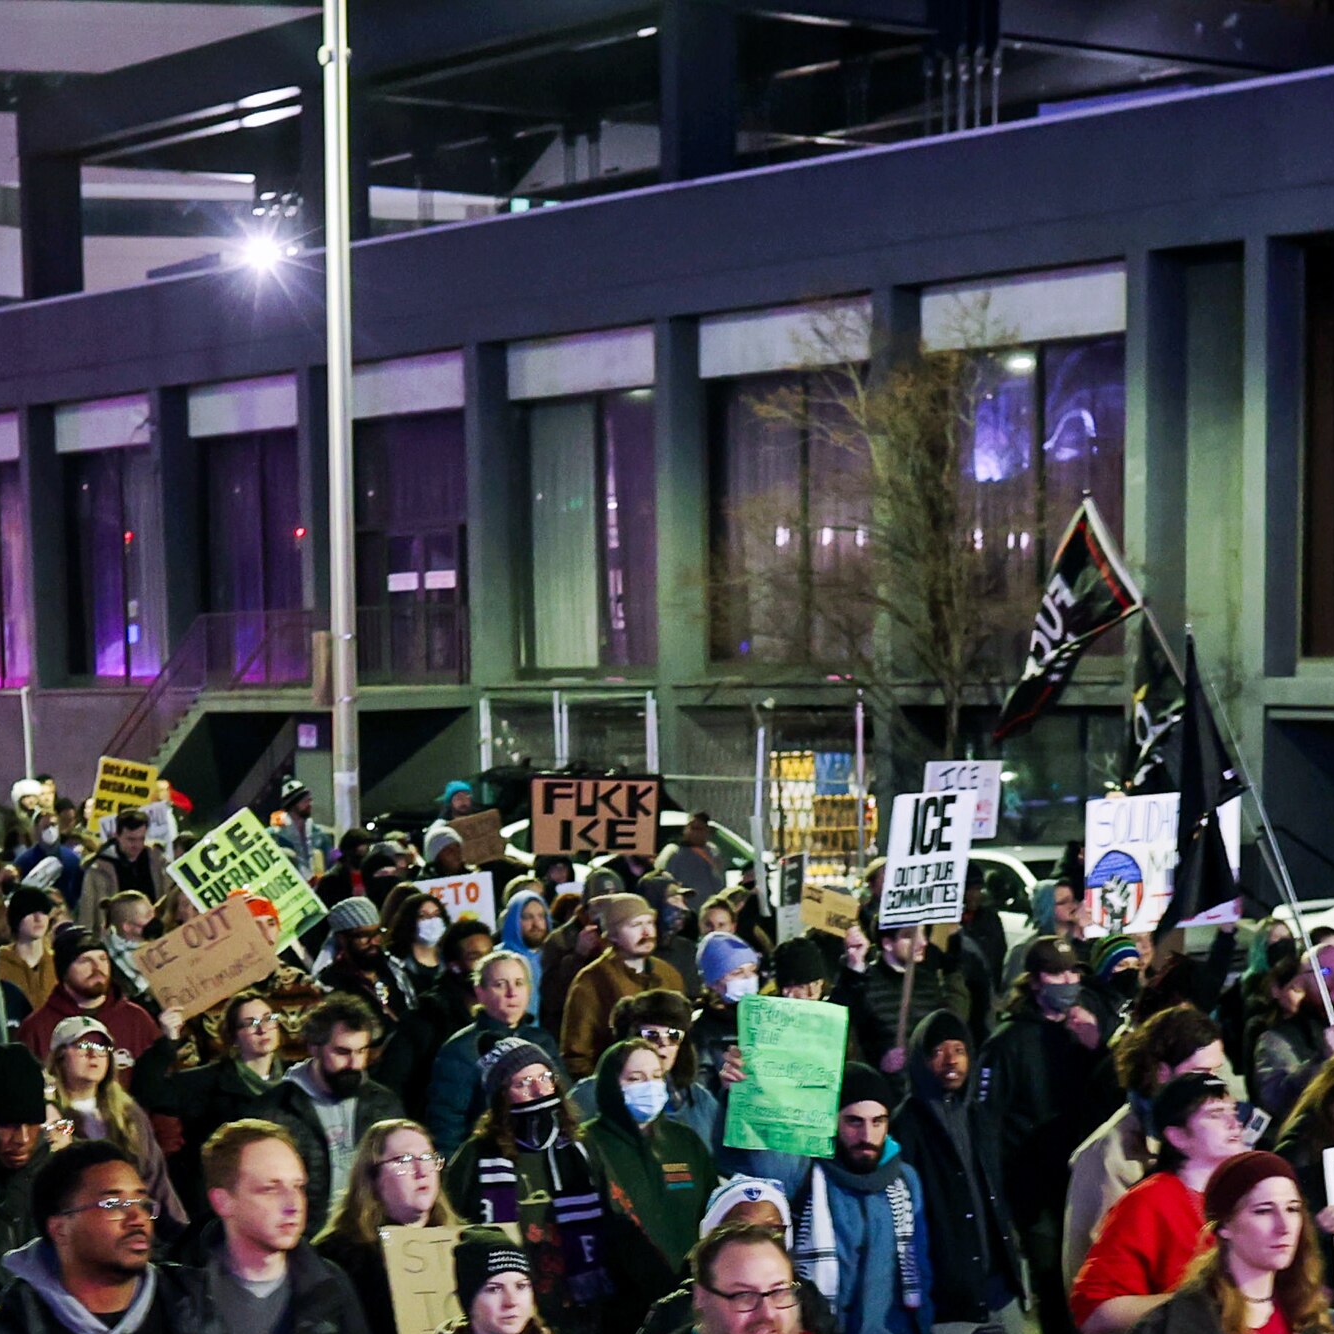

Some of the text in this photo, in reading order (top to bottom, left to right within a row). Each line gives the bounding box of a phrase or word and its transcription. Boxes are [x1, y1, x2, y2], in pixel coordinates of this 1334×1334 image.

[938, 766, 980, 792] ICE
[543, 782, 654, 818] FUCK
[908, 794, 958, 857] ICE
[178, 821, 264, 890] I.C.E.
[198, 859, 260, 909] FUERA
[251, 841, 281, 872] DE
[895, 865, 917, 888] OUT
[918, 862, 933, 884] OF
[886, 882, 959, 911] COMMUNITIES
[139, 904, 232, 974] ICE OUT
[402, 1237, 453, 1275] ST
